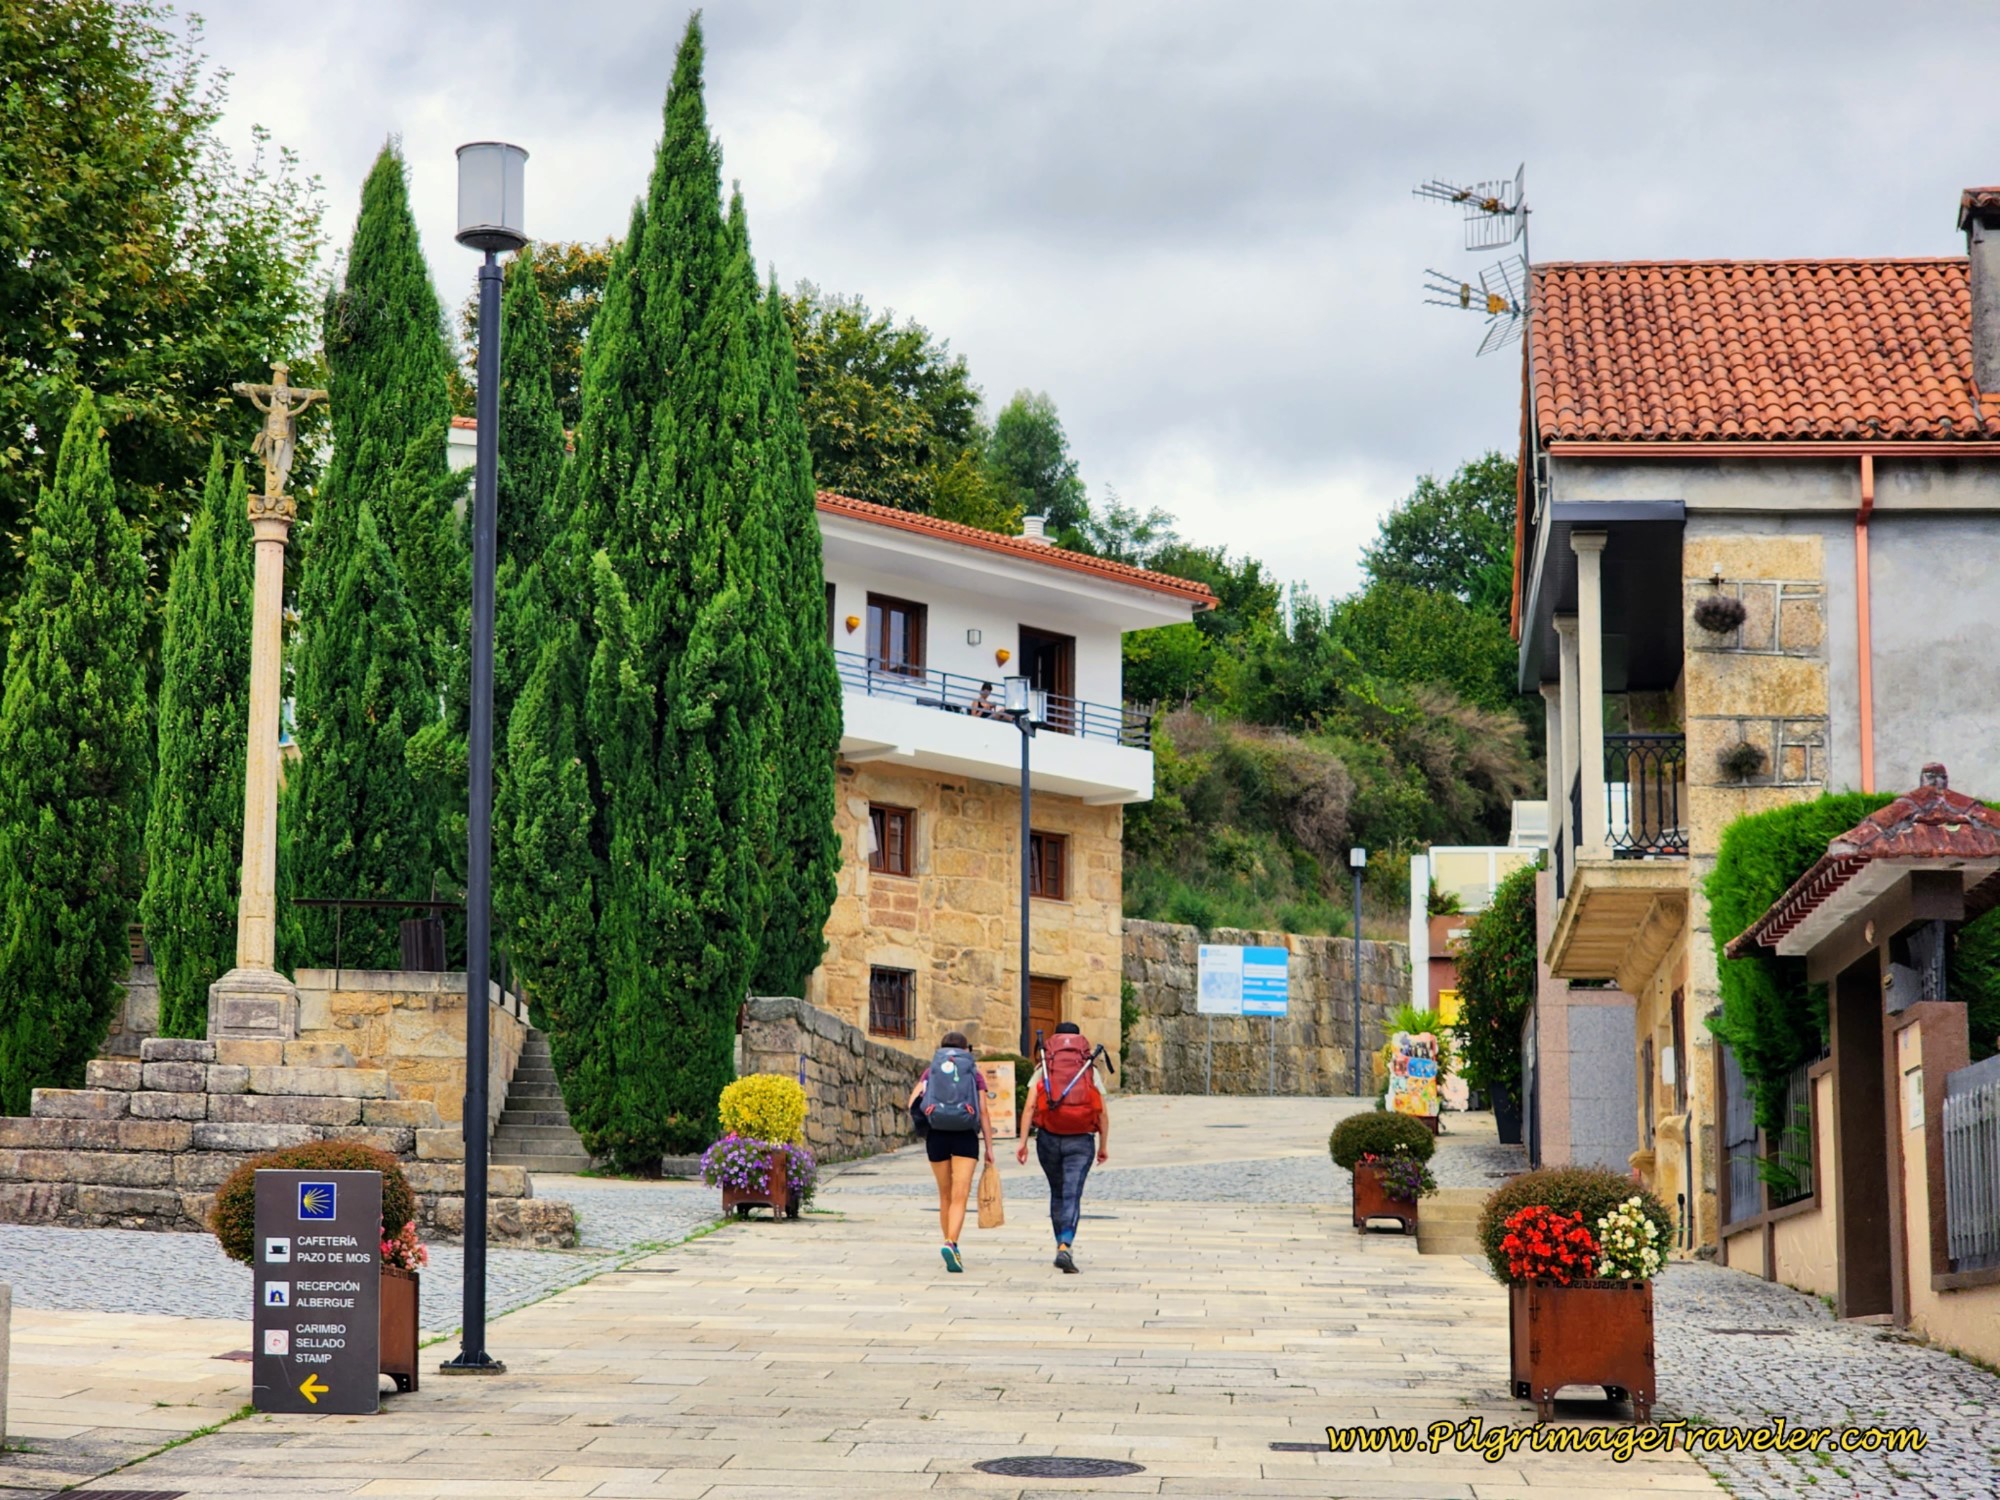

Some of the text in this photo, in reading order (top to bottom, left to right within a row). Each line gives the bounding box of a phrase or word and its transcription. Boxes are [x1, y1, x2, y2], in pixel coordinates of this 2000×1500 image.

[297, 1235, 358, 1247] CAFETERÍA
[297, 1253, 371, 1264] PAZO DE MOS
[296, 1280, 360, 1292] RECEPCIÓN
[296, 1298, 355, 1308] ALBERGUE
[296, 1324, 347, 1334] CARIMBO
[295, 1338, 346, 1349] SELLADO
[295, 1353, 332, 1363] STAMP
